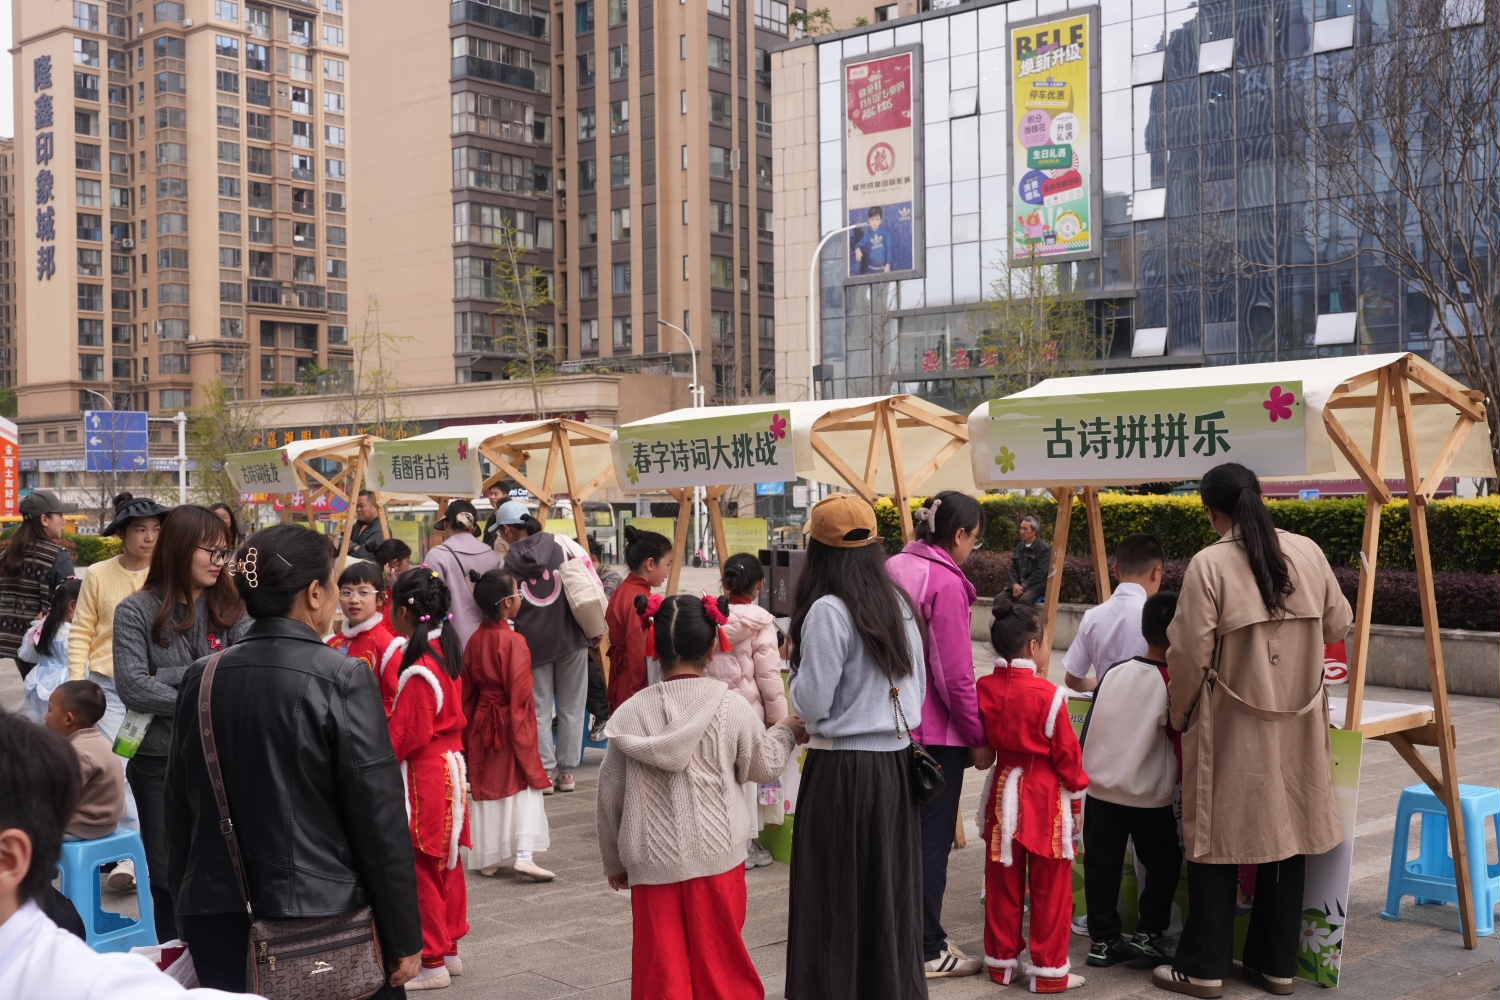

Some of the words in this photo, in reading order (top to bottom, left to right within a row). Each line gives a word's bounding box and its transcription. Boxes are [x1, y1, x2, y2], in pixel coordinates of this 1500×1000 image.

[1017, 43, 1082, 78] 换新升级
[1029, 90, 1066, 100] 停车优惠
[1032, 148, 1066, 160] 生日礼遇
[33, 54, 56, 282] 隆鑫印象城邦
[1043, 410, 1231, 460] 古诗拼拼乐
[633, 430, 778, 474] 春字诗词大挑战
[240, 462, 281, 484] 古诗词接龙
[391, 453, 449, 480] 看图背古诗
[1068, 714, 1084, 724] 社区
